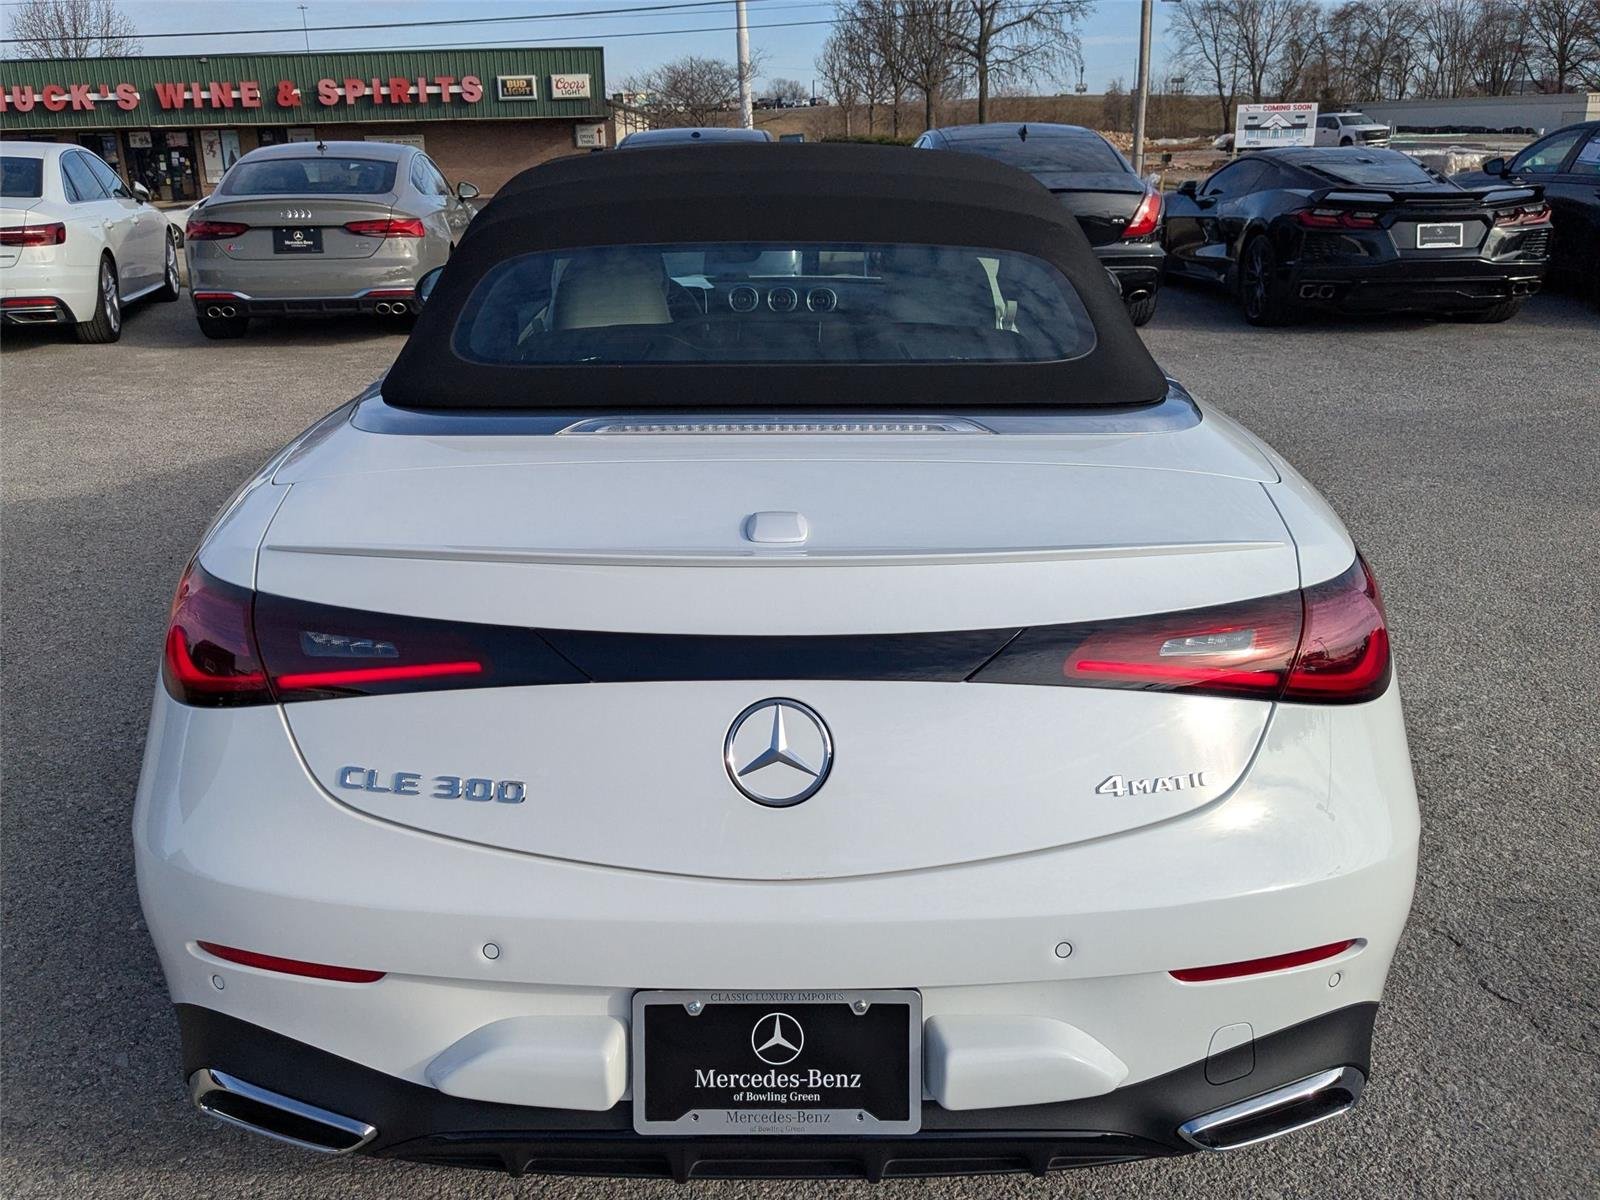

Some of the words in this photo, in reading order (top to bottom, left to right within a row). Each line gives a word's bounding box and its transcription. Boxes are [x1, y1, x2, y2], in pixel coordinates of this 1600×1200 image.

[506, 80, 527, 88] BUD
[555, 78, 586, 90] Coors
[154, 80, 262, 109] WINE
[277, 80, 301, 107] &
[317, 75, 483, 106] SPIRITS
[503, 87, 531, 95] LIGHT
[1263, 104, 1291, 112] COMING
[1293, 103, 1313, 111] SOON
[339, 766, 423, 796] CLE
[431, 776, 527, 804] 300
[710, 992, 753, 1001] CLASSIC
[755, 992, 796, 1001] LUXURY
[798, 992, 846, 1001] IMPORTS
[694, 1069, 861, 1088] Mercedes-Benz
[733, 1092, 744, 1101] of
[746, 1092, 787, 1103] Bowling
[789, 1092, 821, 1101] Green
[726, 1111, 831, 1124] Mercedes-Benz
